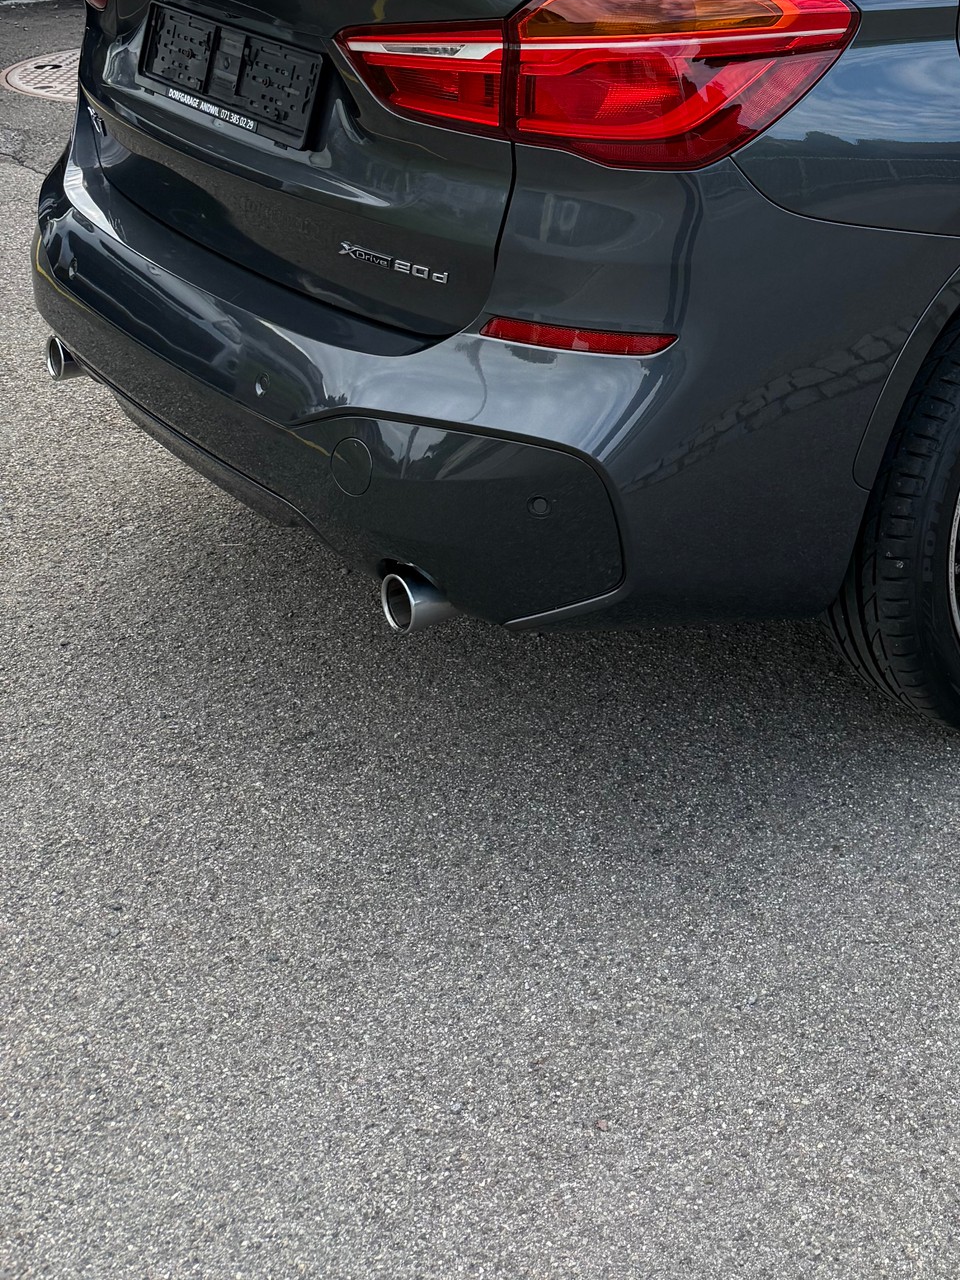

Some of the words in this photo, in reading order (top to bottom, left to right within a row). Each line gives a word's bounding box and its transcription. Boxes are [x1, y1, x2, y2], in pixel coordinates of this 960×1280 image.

[168, 88, 200, 108] DORFGARAGE
[199, 101, 220, 117] ANDWIL
[220, 109, 230, 121] 071
[229, 113, 240, 124] 385
[239, 117, 247, 128] 02
[246, 120, 255, 130] 29
